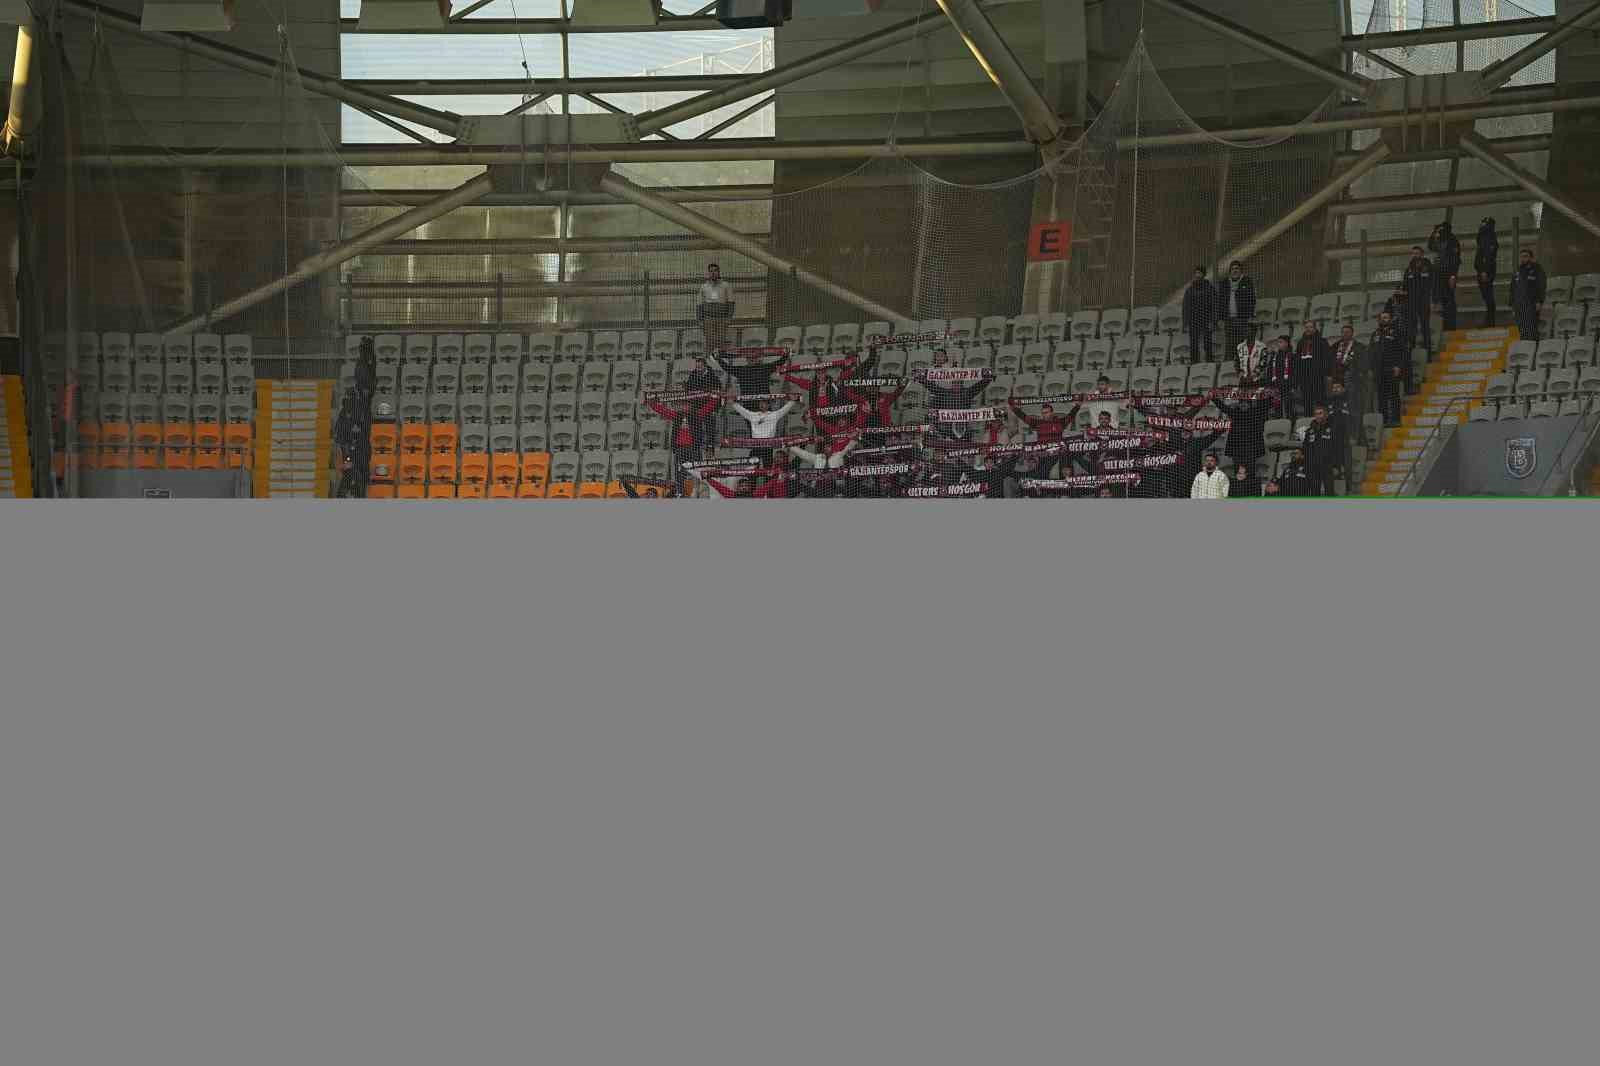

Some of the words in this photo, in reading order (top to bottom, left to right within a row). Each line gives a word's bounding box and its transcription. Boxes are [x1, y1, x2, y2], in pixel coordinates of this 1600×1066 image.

[1040, 229, 1060, 254] E
[1148, 416, 1183, 428] ULTRAS
[1069, 441, 1099, 451] ULTRAS
[908, 487, 939, 497] ULTRAS
